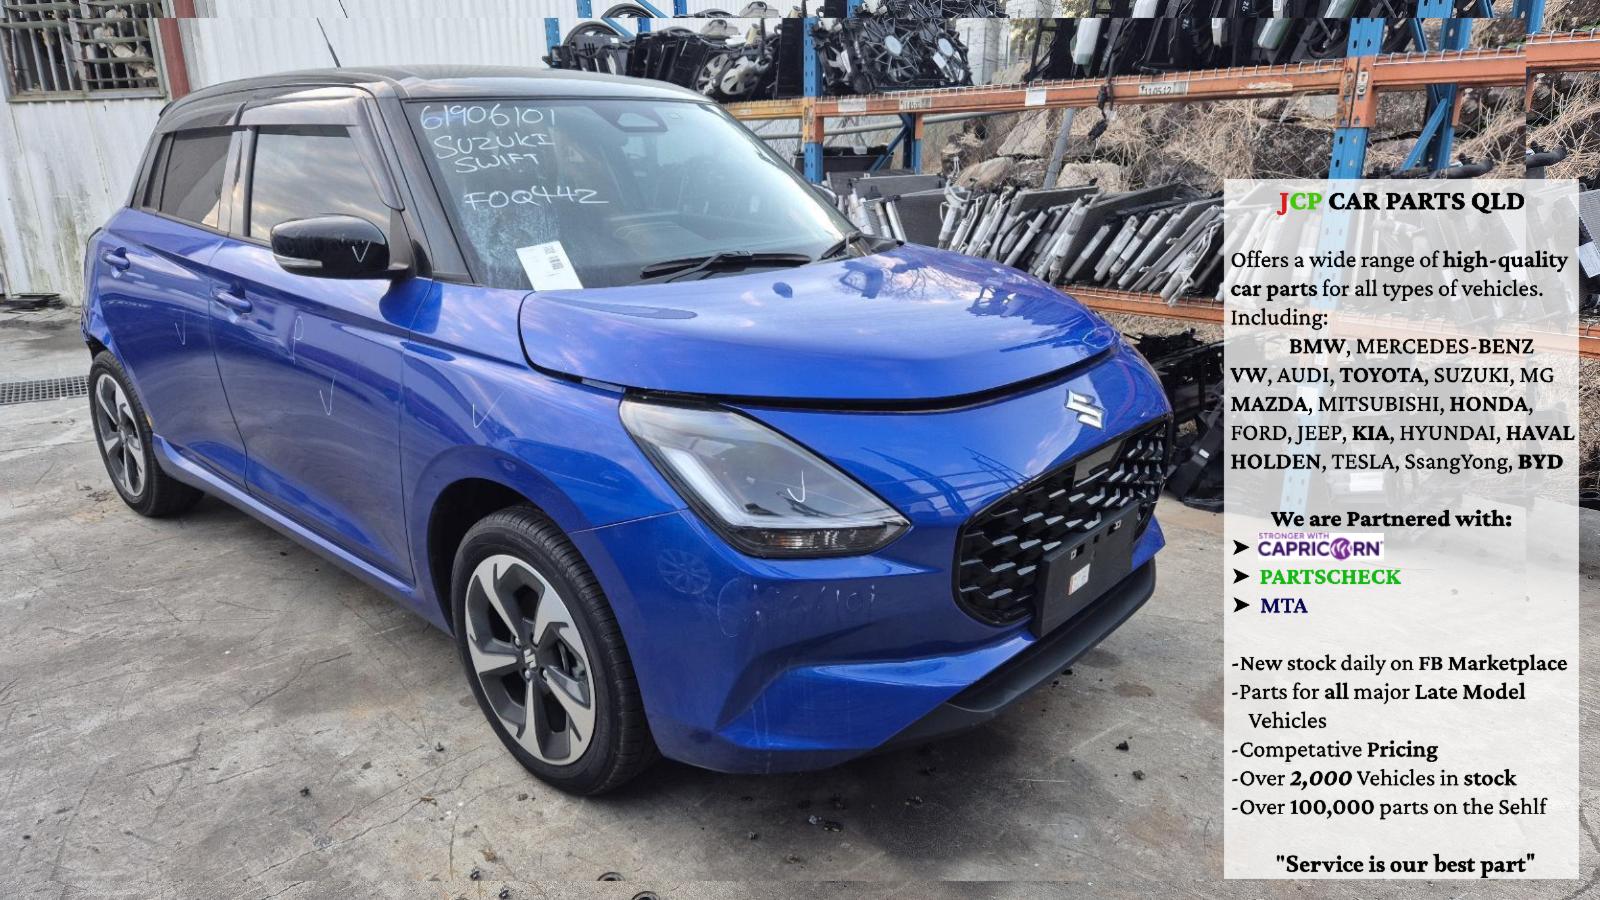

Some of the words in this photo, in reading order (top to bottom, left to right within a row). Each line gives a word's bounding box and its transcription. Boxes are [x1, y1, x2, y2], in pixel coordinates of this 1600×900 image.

[420, 103, 556, 130] 61906101
[434, 132, 556, 159] SUZUKI
[455, 153, 540, 173] SWIFT
